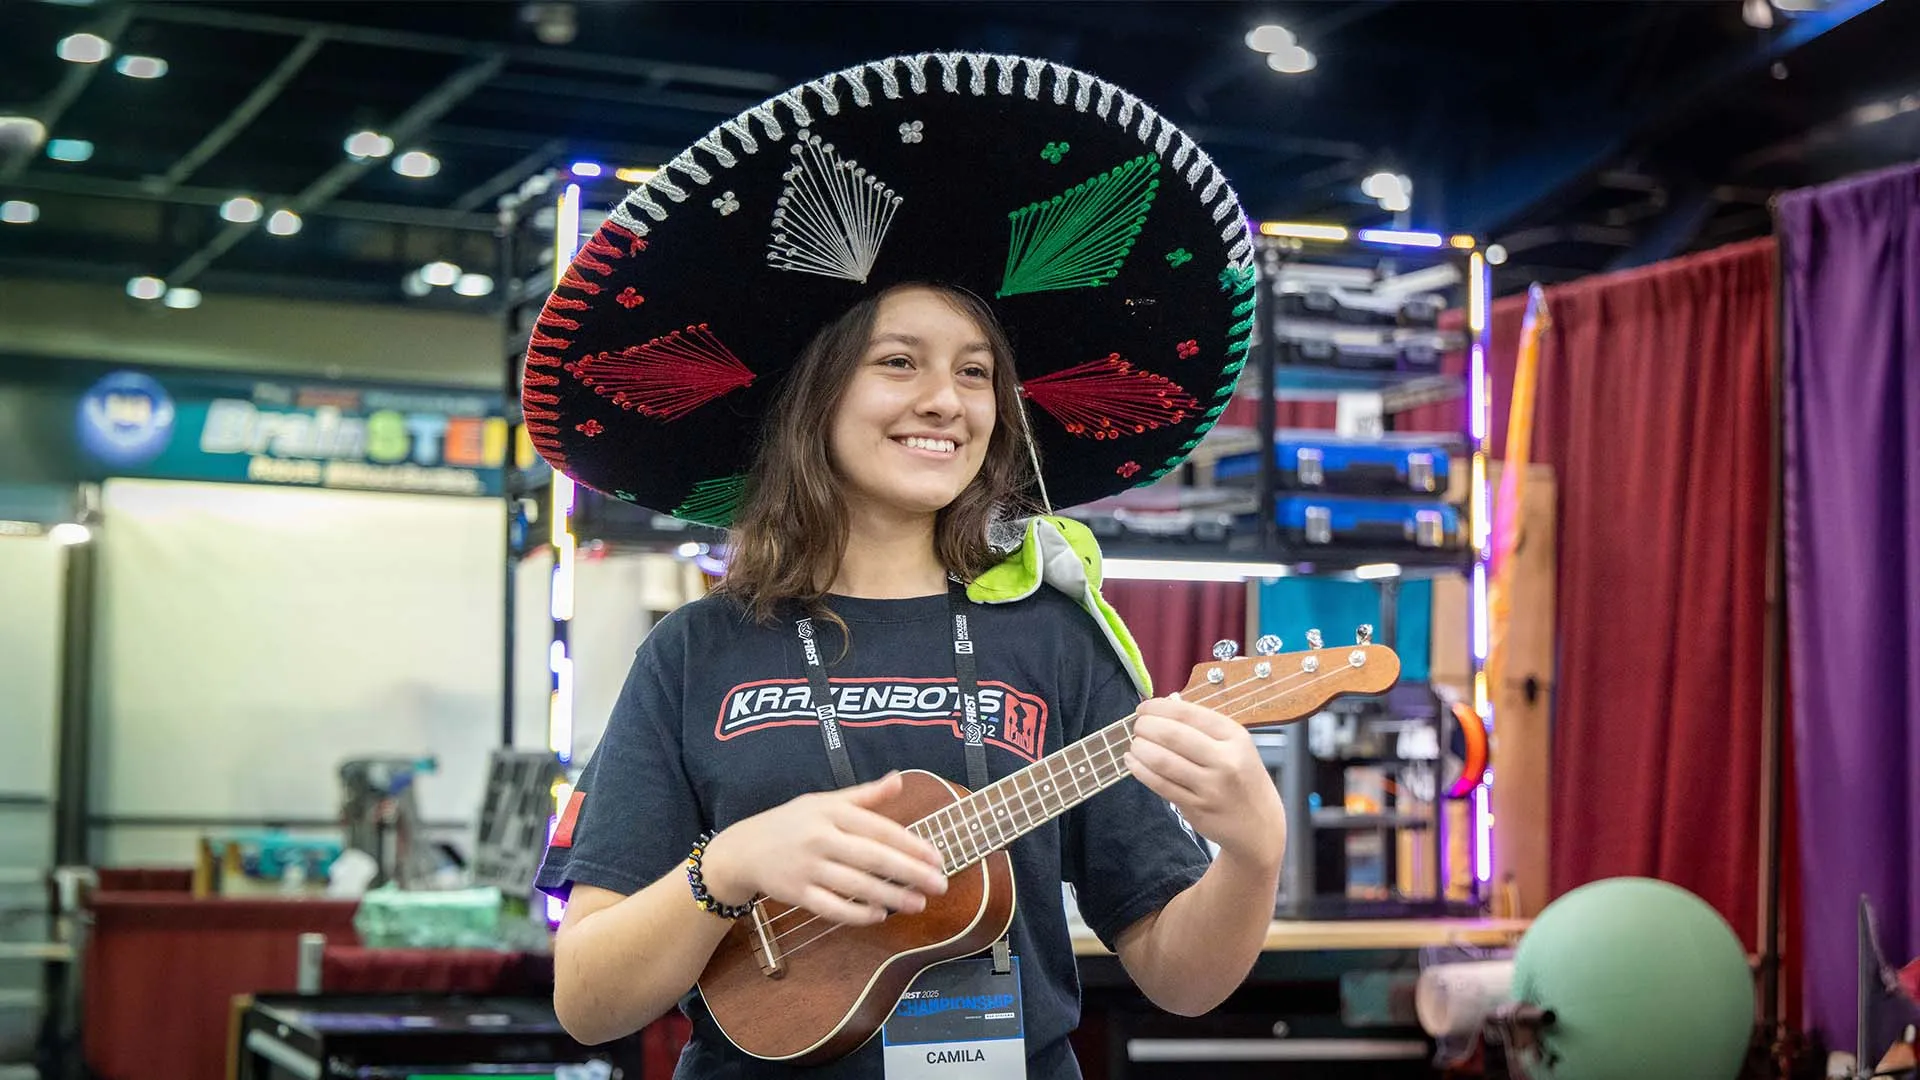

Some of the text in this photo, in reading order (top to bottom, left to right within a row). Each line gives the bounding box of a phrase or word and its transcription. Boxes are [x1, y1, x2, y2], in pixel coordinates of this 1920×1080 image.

[803, 638, 820, 666] FIRST
[963, 693, 978, 723] FIRST
[896, 994, 1014, 1017] CHAMPIONSHIP
[921, 990, 940, 999] 2025
[926, 1049, 985, 1065] CAMILA
